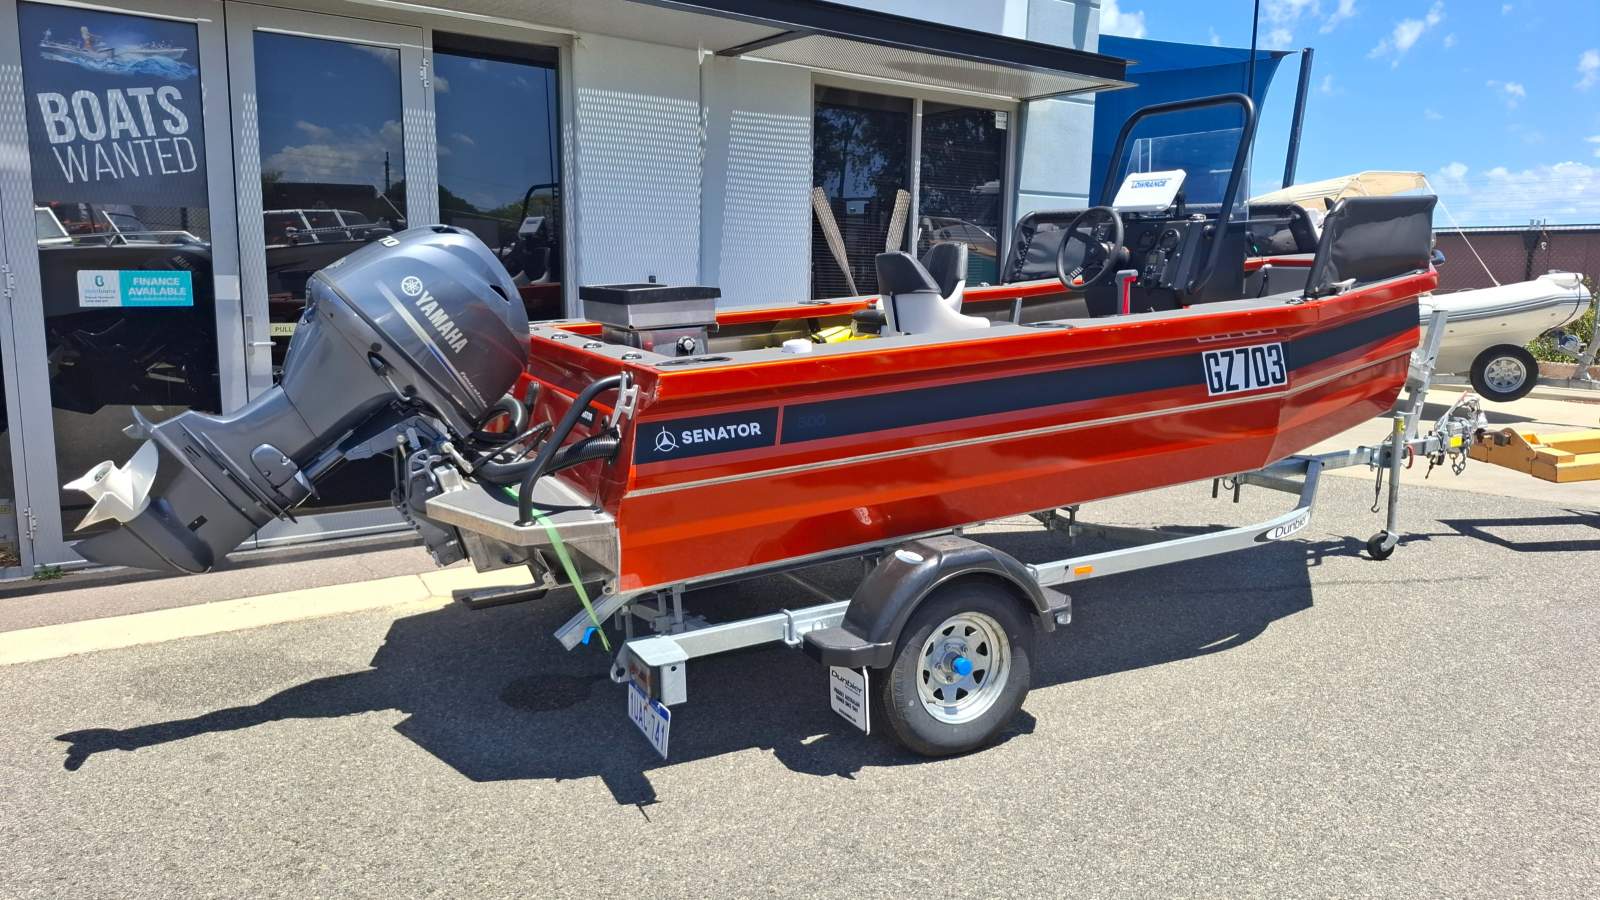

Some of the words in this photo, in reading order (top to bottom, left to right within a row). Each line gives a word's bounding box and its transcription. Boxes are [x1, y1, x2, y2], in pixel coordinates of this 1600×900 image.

[36, 85, 189, 144] BOATS
[52, 137, 197, 184] WANTED
[1131, 179, 1168, 189] LOWRANCE
[128, 287, 187, 296] AVAILABLE
[133, 276, 180, 286] FINANCE
[415, 290, 468, 354] YAMAHA
[1205, 344, 1286, 394] GZ703
[681, 422, 762, 444] SENATOR
[831, 670, 862, 694] Dunbier
